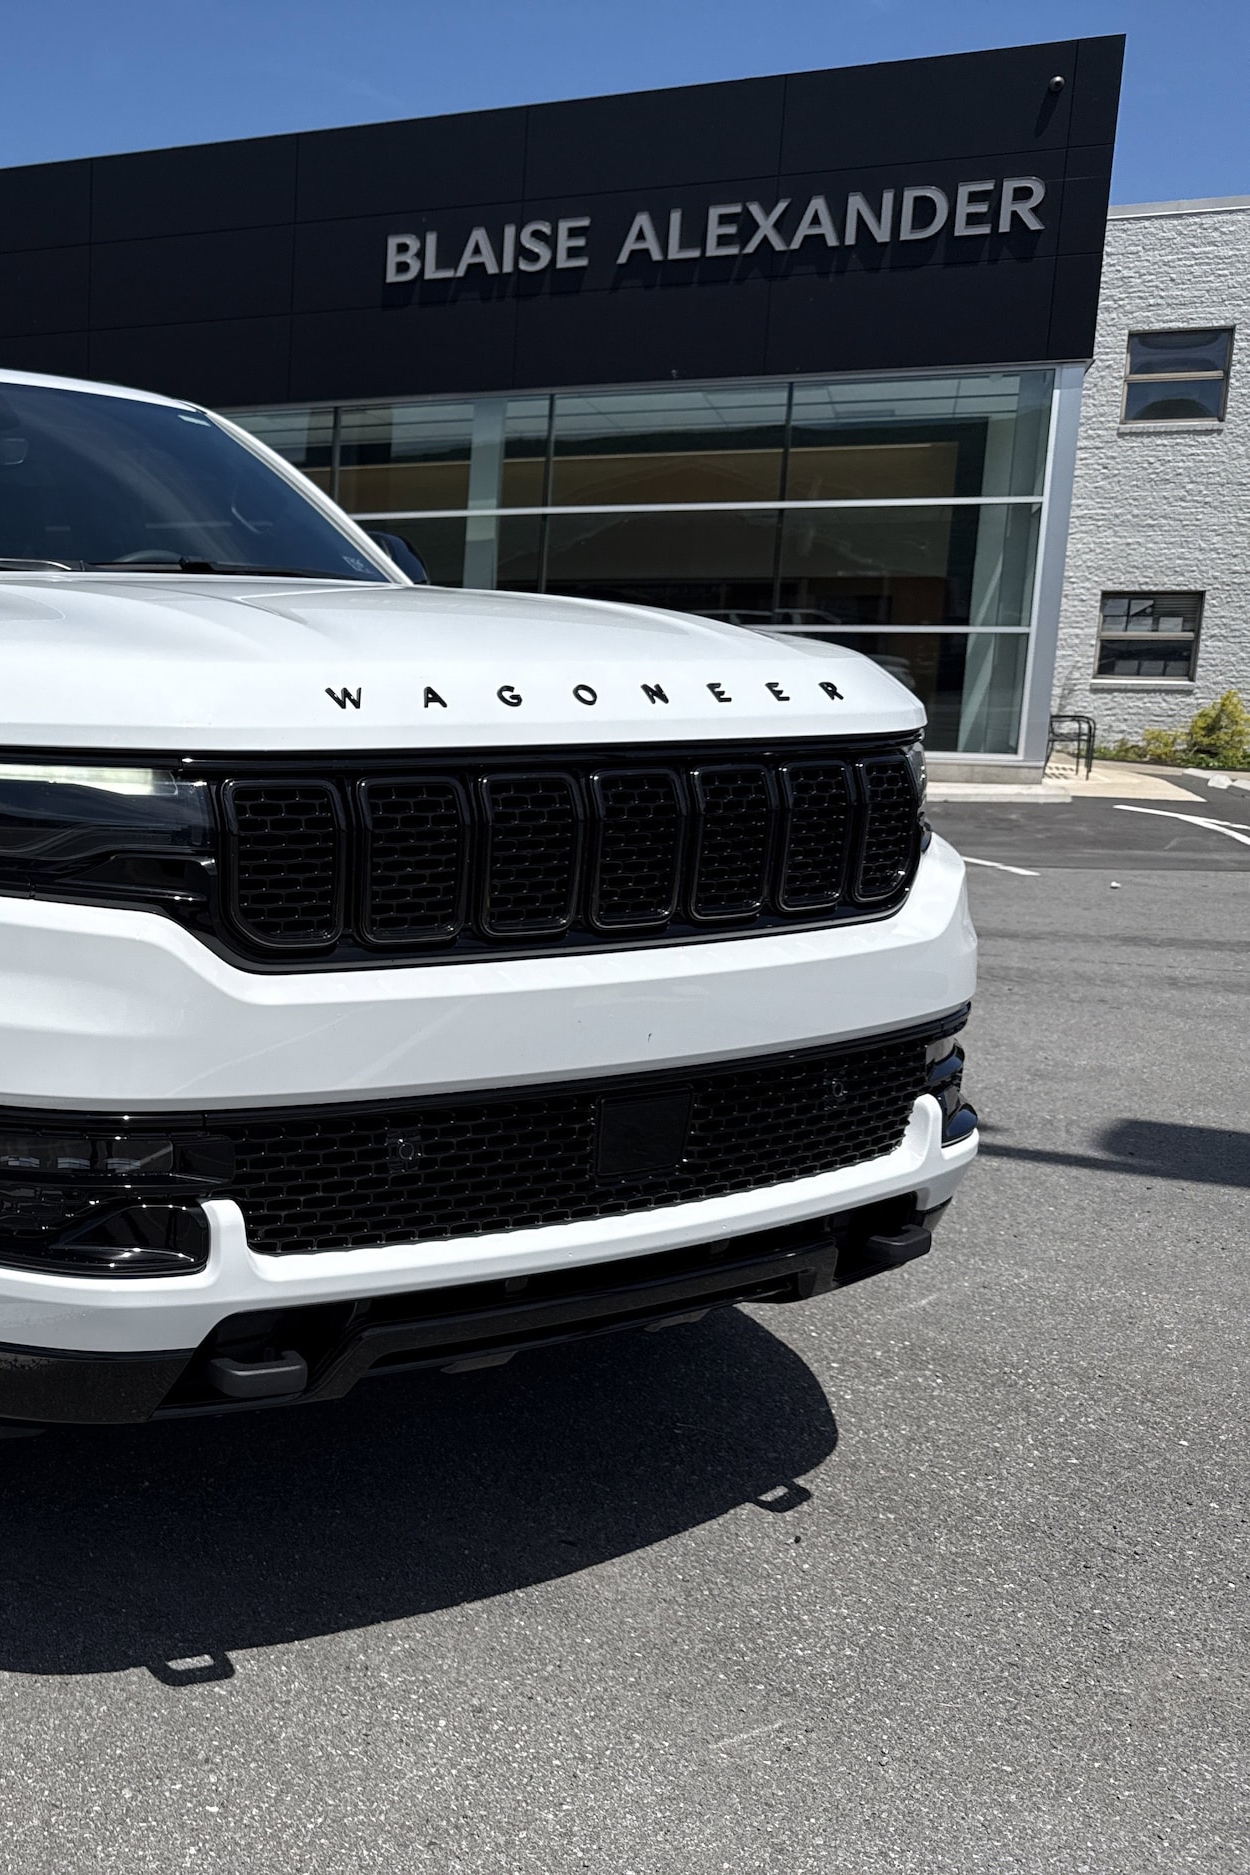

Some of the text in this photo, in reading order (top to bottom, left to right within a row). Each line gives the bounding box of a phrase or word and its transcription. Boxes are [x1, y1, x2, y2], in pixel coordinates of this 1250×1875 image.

[385, 176, 1046, 283] BLAISE ALEXANDER
[325, 681, 844, 710] WAGONEER
